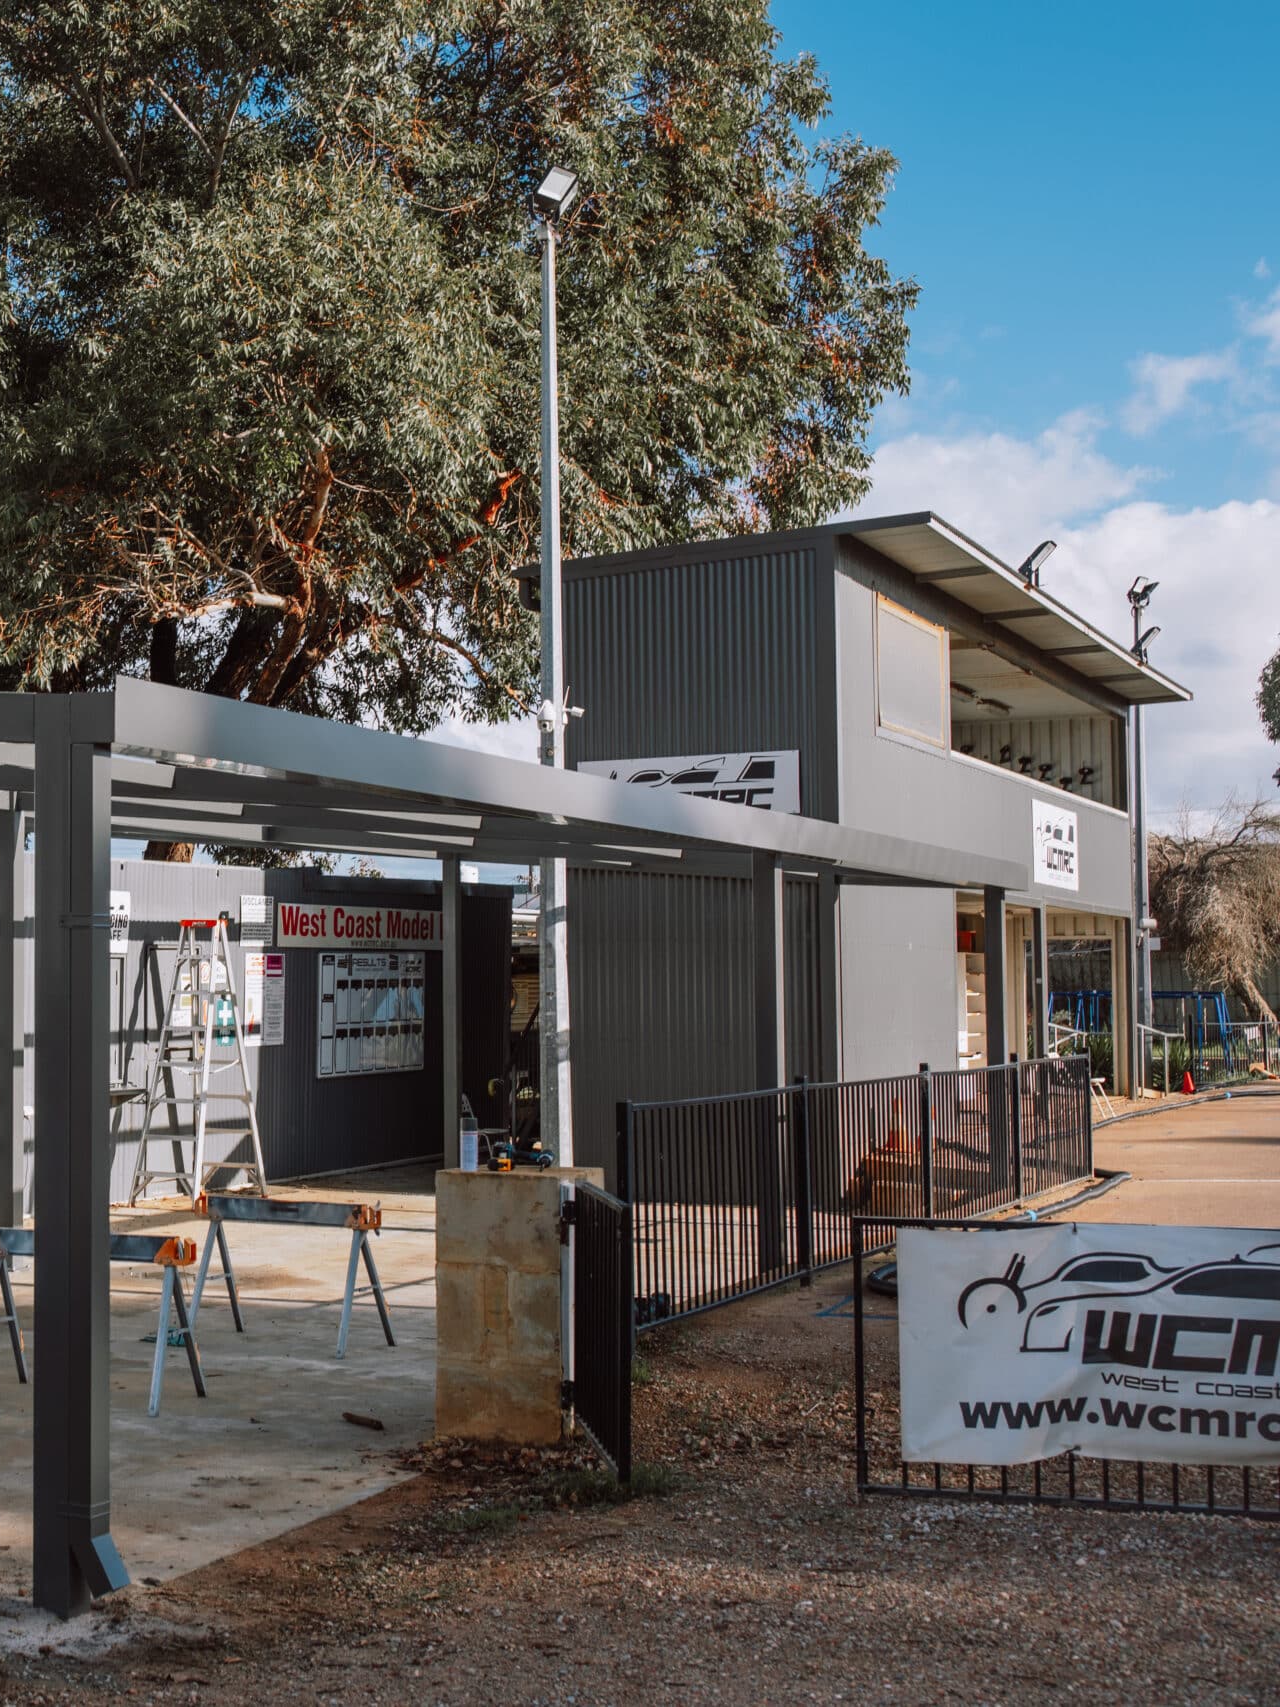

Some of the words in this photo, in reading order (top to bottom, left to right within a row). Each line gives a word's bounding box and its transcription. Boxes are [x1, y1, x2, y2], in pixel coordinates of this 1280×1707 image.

[110, 914, 128, 928] CING
[281, 905, 327, 937] West
[333, 907, 382, 938] Coast
[387, 911, 434, 940] Model
[1101, 1371, 1180, 1393] west
